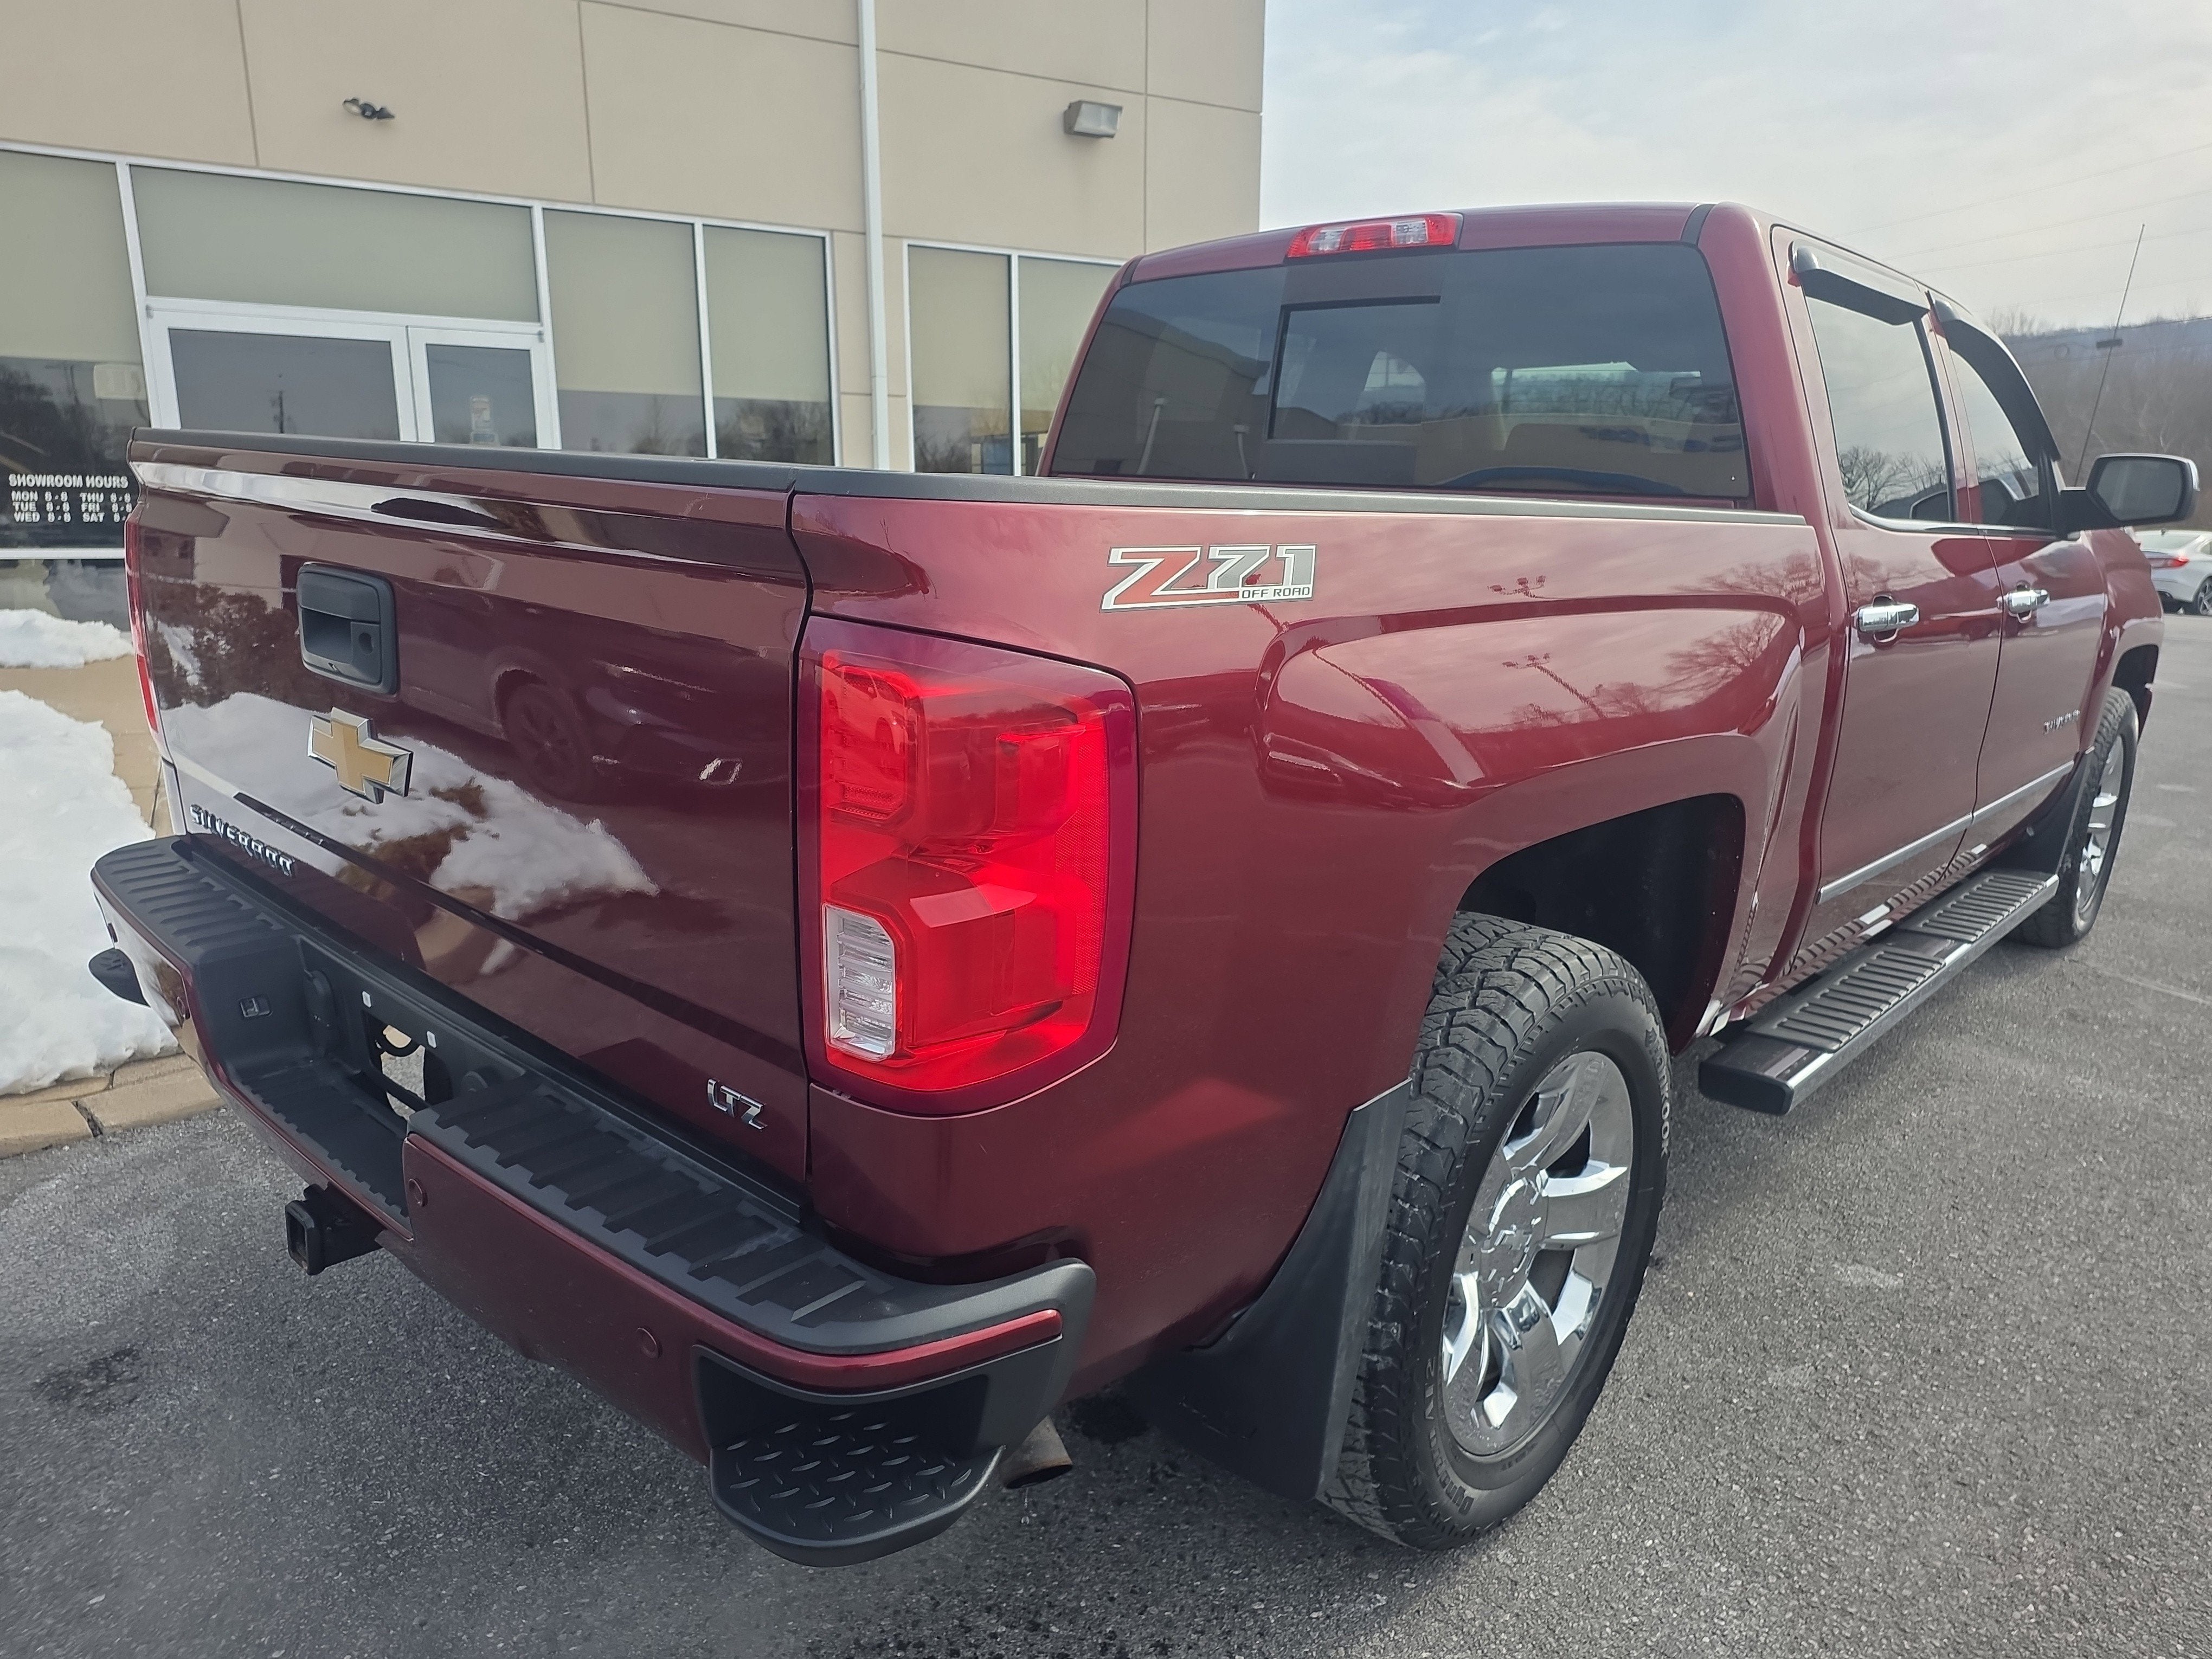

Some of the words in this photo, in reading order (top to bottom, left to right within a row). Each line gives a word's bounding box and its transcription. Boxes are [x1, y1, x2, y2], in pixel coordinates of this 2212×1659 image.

[9, 474, 83, 487] SHOWROOM
[85, 475, 129, 488] HOURS
[11, 491, 38, 501] MON
[80, 492, 104, 503] THU
[12, 501, 37, 512] TUE
[81, 503, 100, 512] FRI
[14, 512, 40, 522] WED
[82, 512, 105, 523] SAT
[1099, 543, 1318, 613] Z71
[1242, 589, 1269, 599] OFF
[1273, 587, 1310, 597] ROAD
[707, 1078, 768, 1130] LTZ
